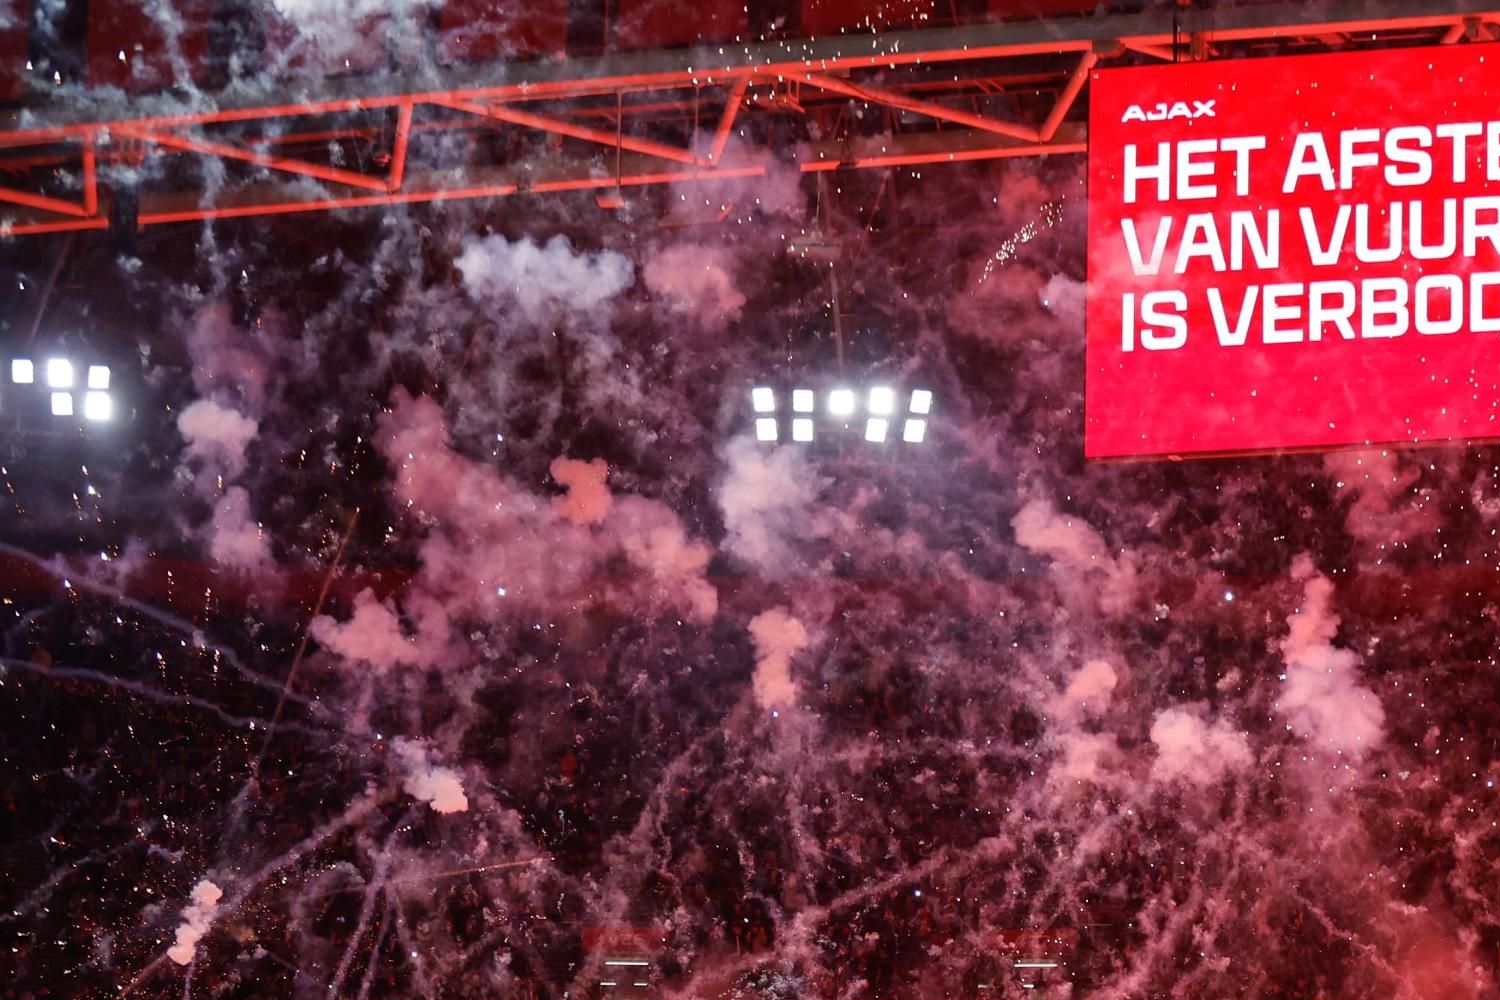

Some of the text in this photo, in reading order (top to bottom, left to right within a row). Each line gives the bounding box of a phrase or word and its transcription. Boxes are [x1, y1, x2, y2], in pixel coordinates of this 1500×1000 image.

[1121, 100, 1216, 122] AJAX
[1123, 135, 1266, 203] HET
[1120, 208, 1280, 277] VAN
[1121, 289, 1189, 353] IS
